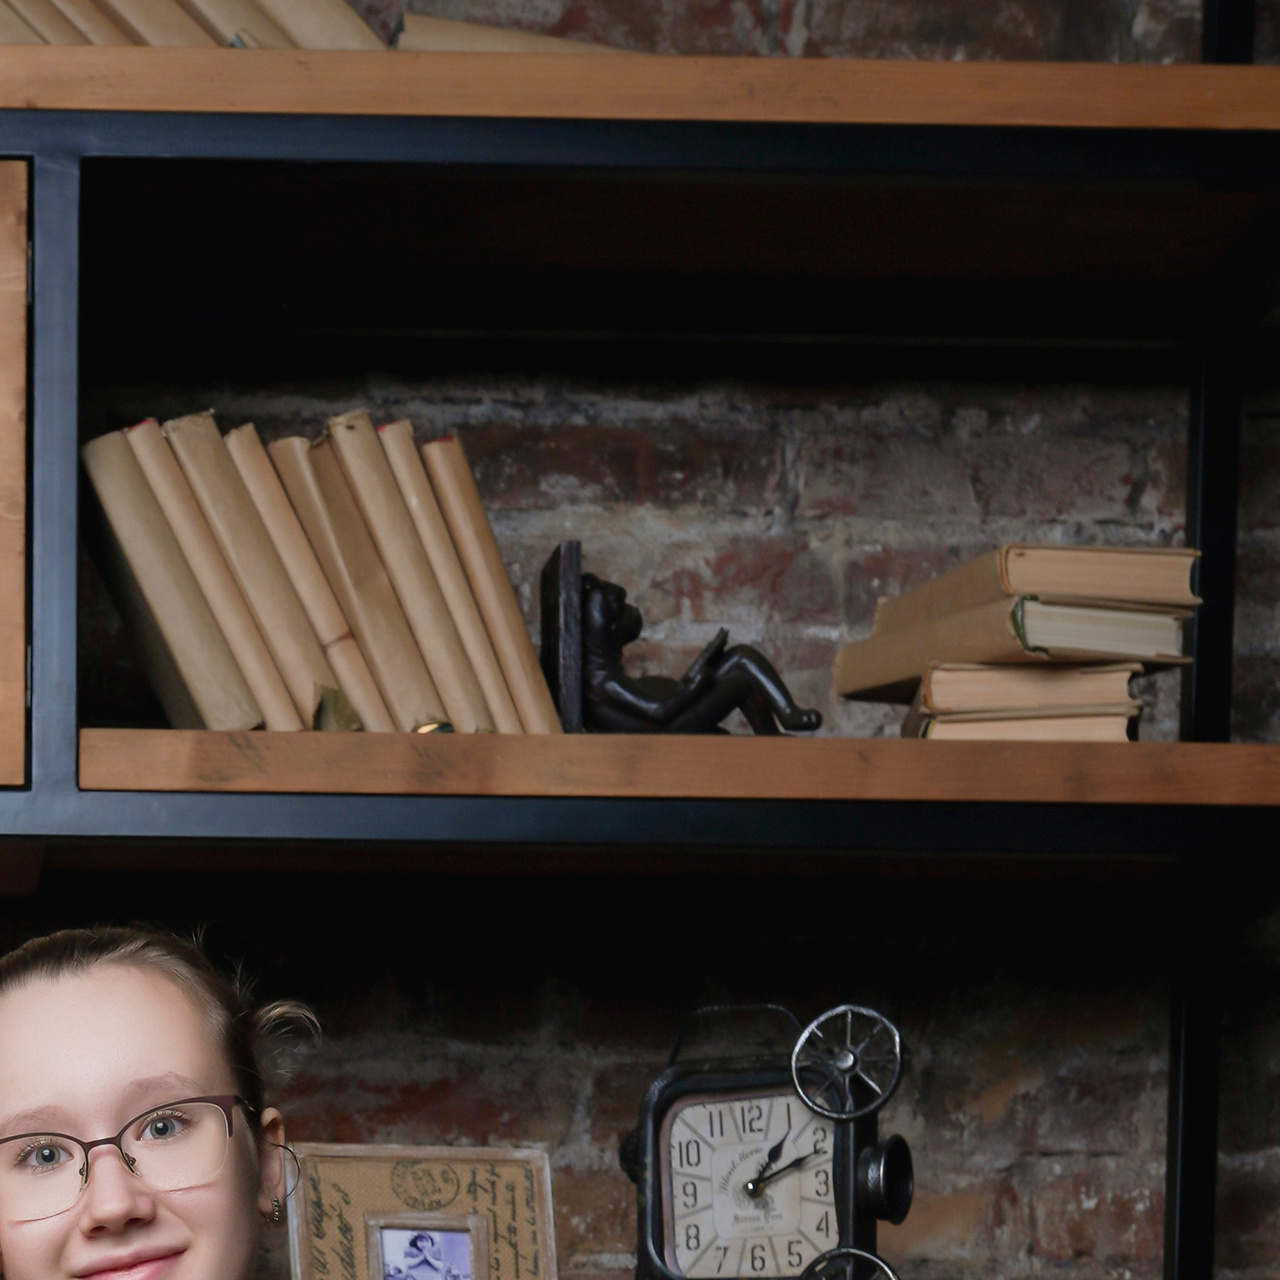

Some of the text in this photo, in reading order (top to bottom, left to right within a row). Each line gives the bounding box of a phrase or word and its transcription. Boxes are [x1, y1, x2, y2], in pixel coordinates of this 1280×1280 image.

[709, 1110, 723, 1138] 11
[741, 1105, 764, 1134] 12
[678, 1139, 700, 1168] 10
[813, 1126, 828, 1155] 2
[683, 1181, 698, 1209] 9
[815, 1169, 829, 1198] 3
[685, 1223, 700, 1251] 8
[816, 1210, 829, 1239] 4
[715, 1246, 728, 1274] 7
[751, 1244, 765, 1272] 6
[788, 1240, 802, 1268] 5
